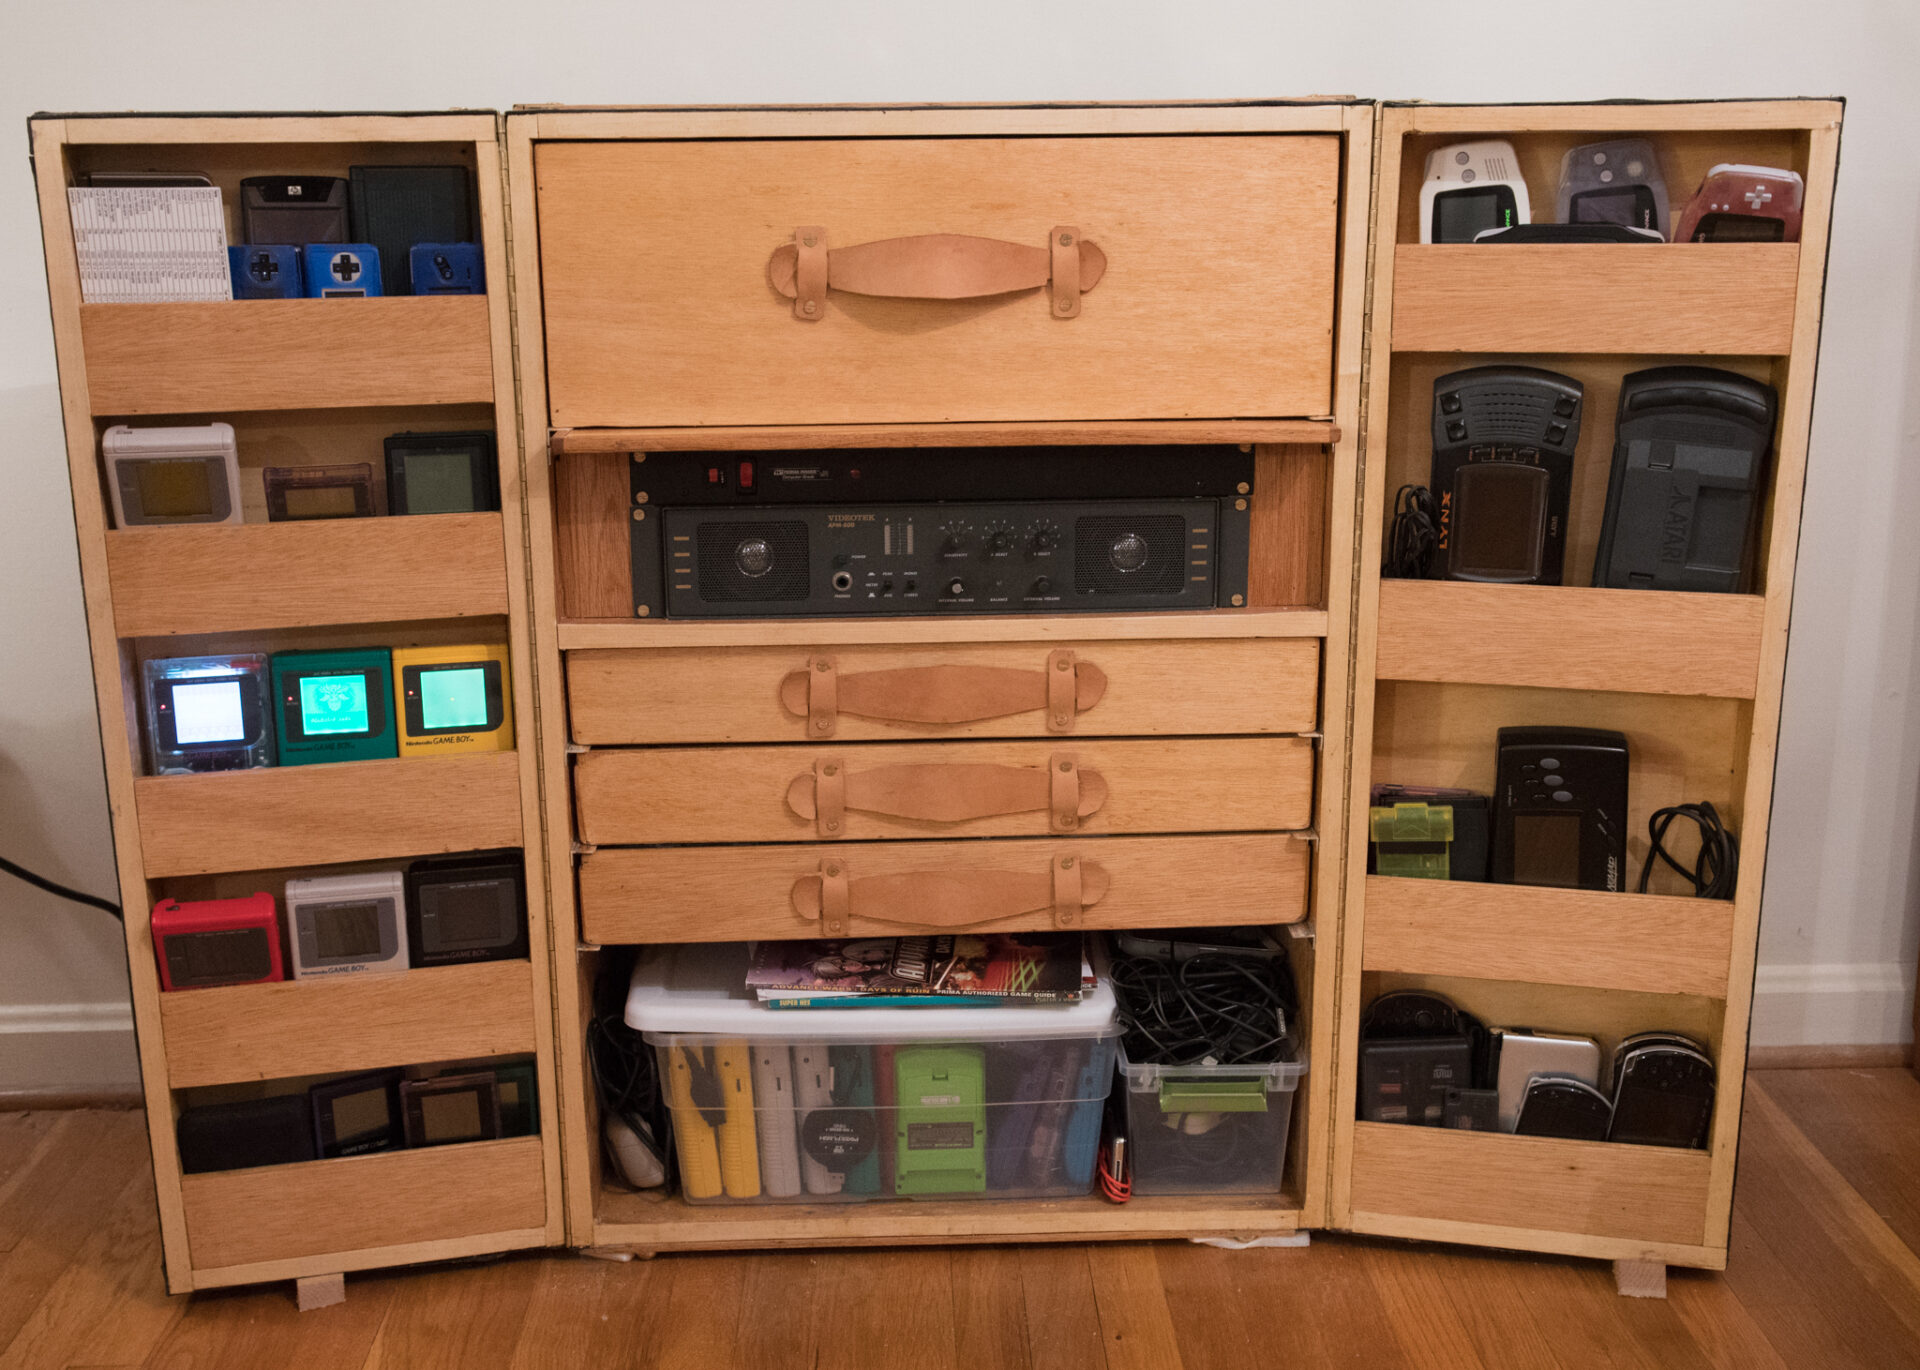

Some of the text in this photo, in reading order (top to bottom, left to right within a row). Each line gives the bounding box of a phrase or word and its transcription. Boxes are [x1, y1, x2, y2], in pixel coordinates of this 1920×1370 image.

[1439, 491, 1452, 550] LYNX
[433, 736, 454, 745] GAME
[328, 966, 350, 974] GAME
